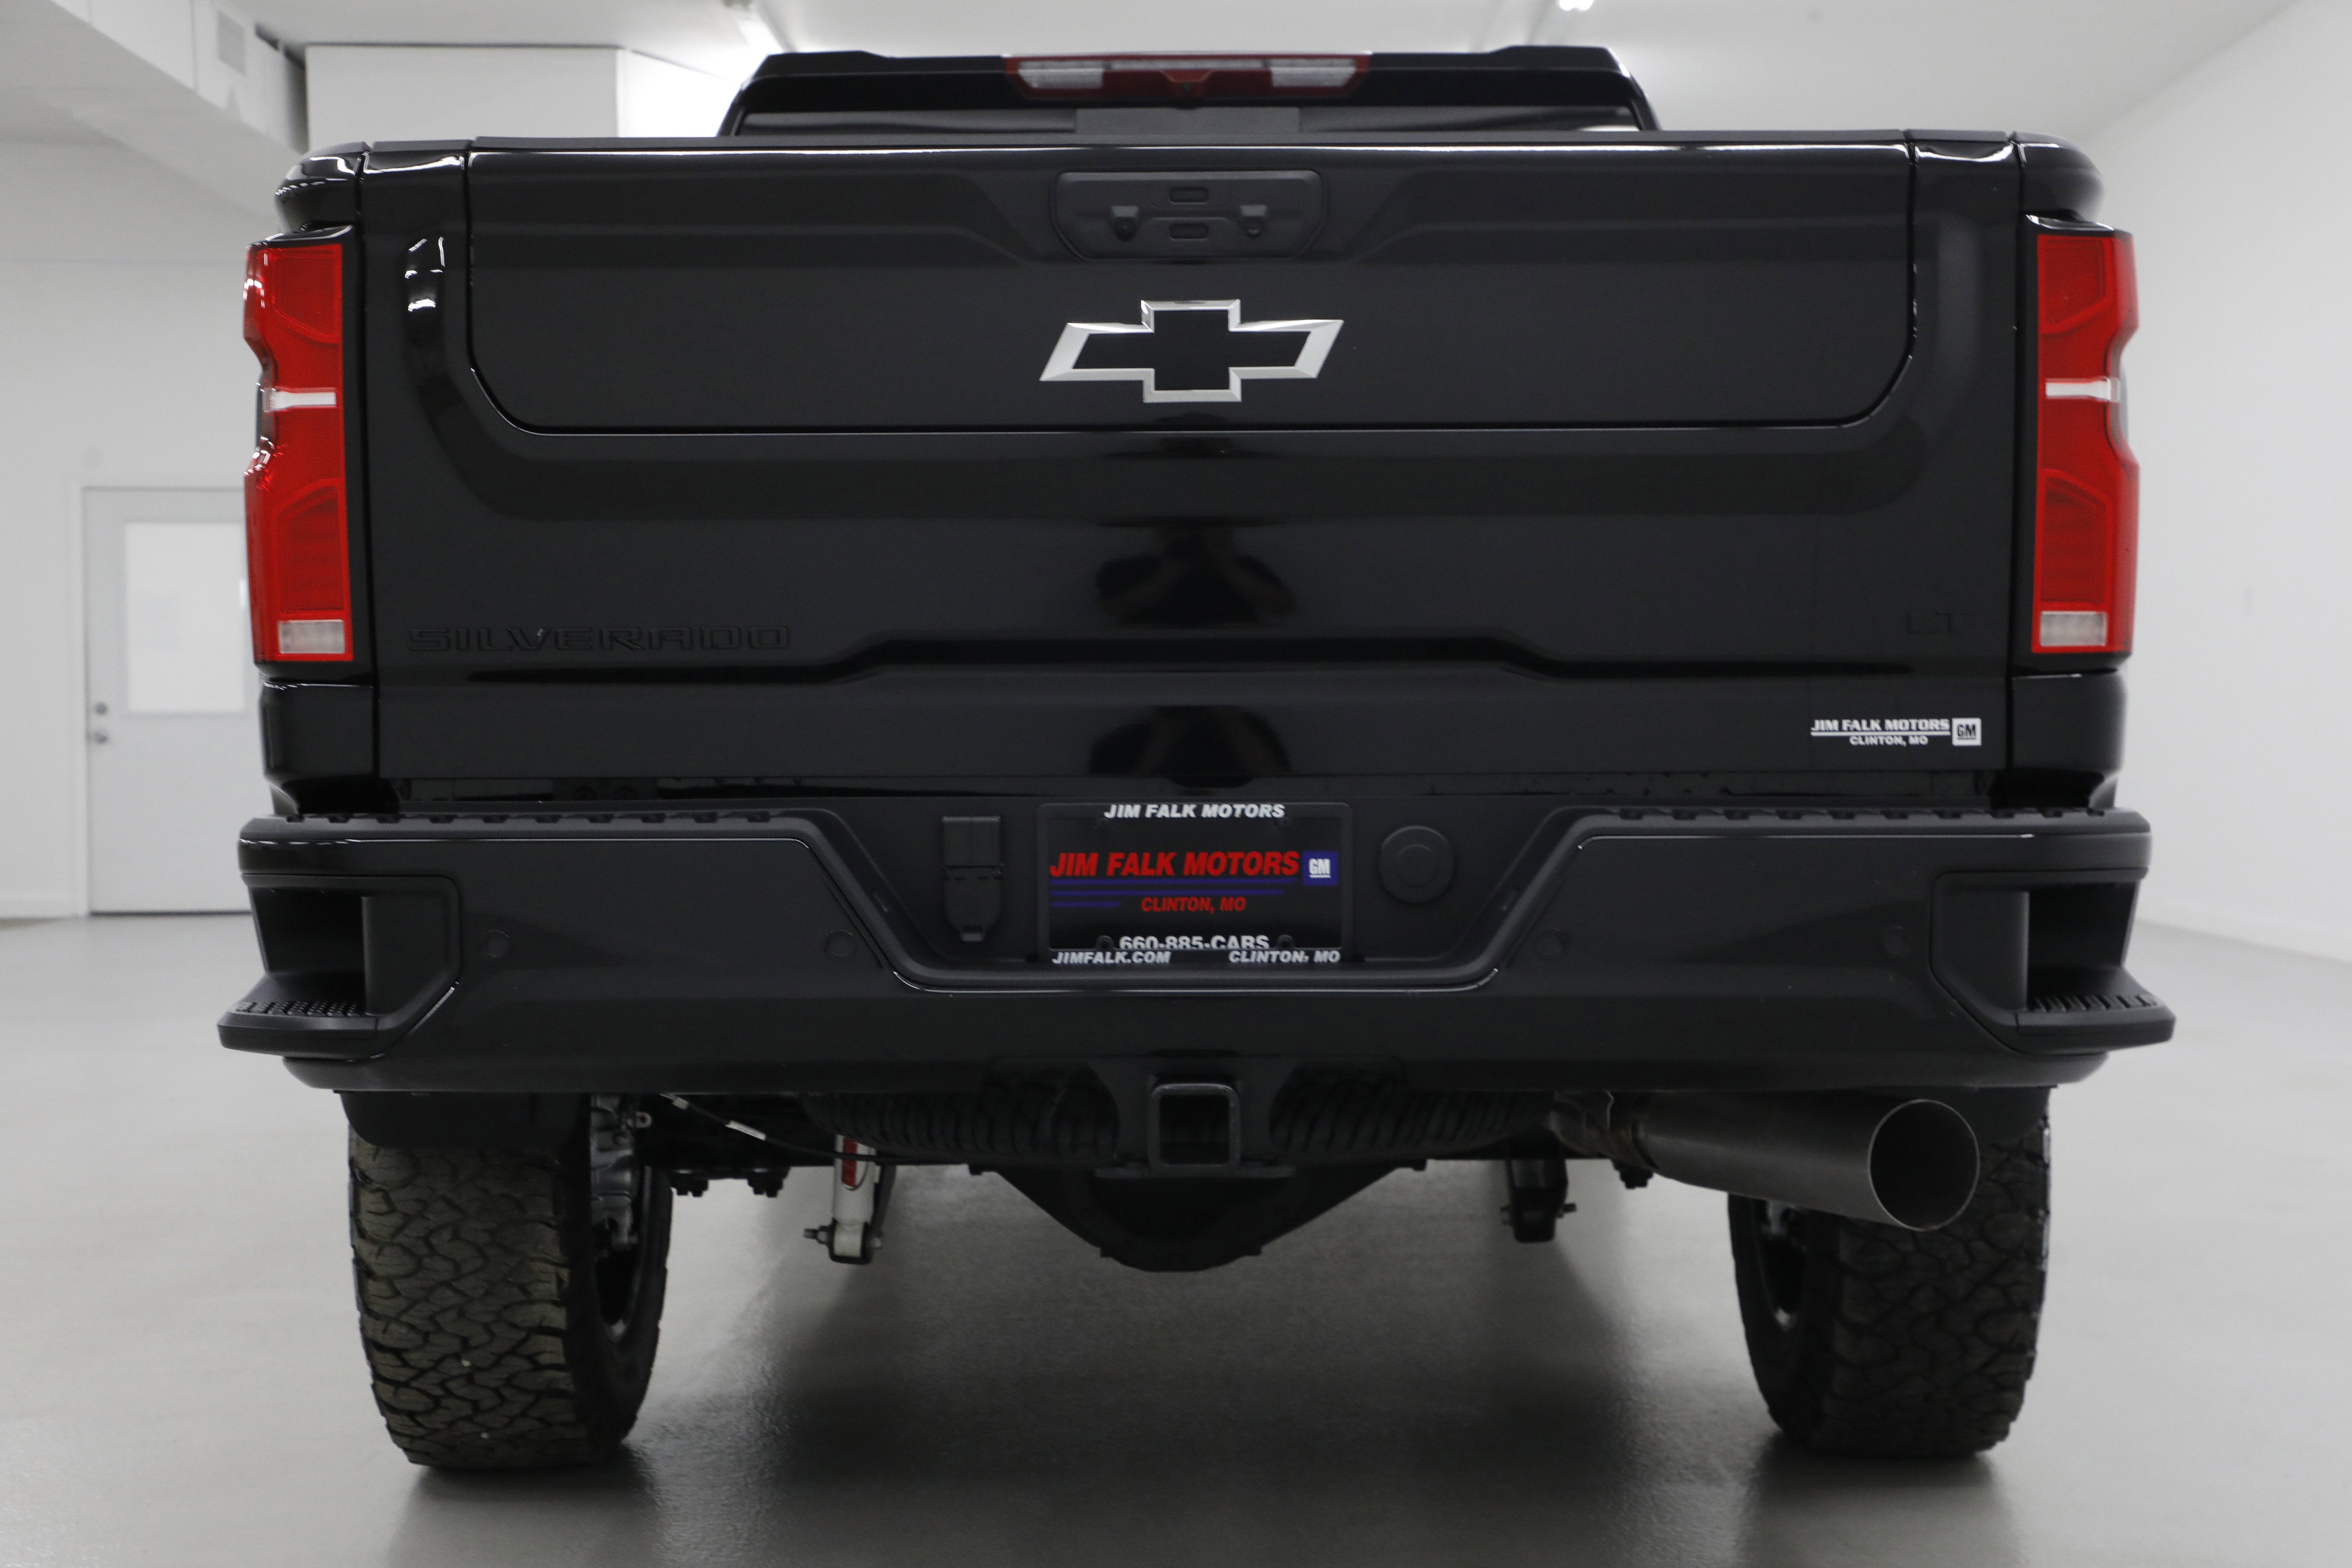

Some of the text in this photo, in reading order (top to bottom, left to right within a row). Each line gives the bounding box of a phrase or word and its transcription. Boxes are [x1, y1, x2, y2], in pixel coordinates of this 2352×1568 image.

[409, 626, 790, 652] SILVERADO
[1810, 718, 1951, 731] JIM FALK MOTORS
[1957, 724, 1976, 737] GM
[1849, 736, 1929, 747] CLINTON, MO
[1104, 803, 1285, 818] JIM FALK MOTORS
[1050, 851, 1300, 877] JIM FALK MOTORS
[1309, 858, 1331, 875] GM
[1141, 896, 1247, 914] CLINTON, MO
[1119, 934, 1270, 949] 660-885-CARS
[1051, 951, 1172, 964] JIMFALK.COM
[1228, 950, 1341, 963] CLINTON, MO
